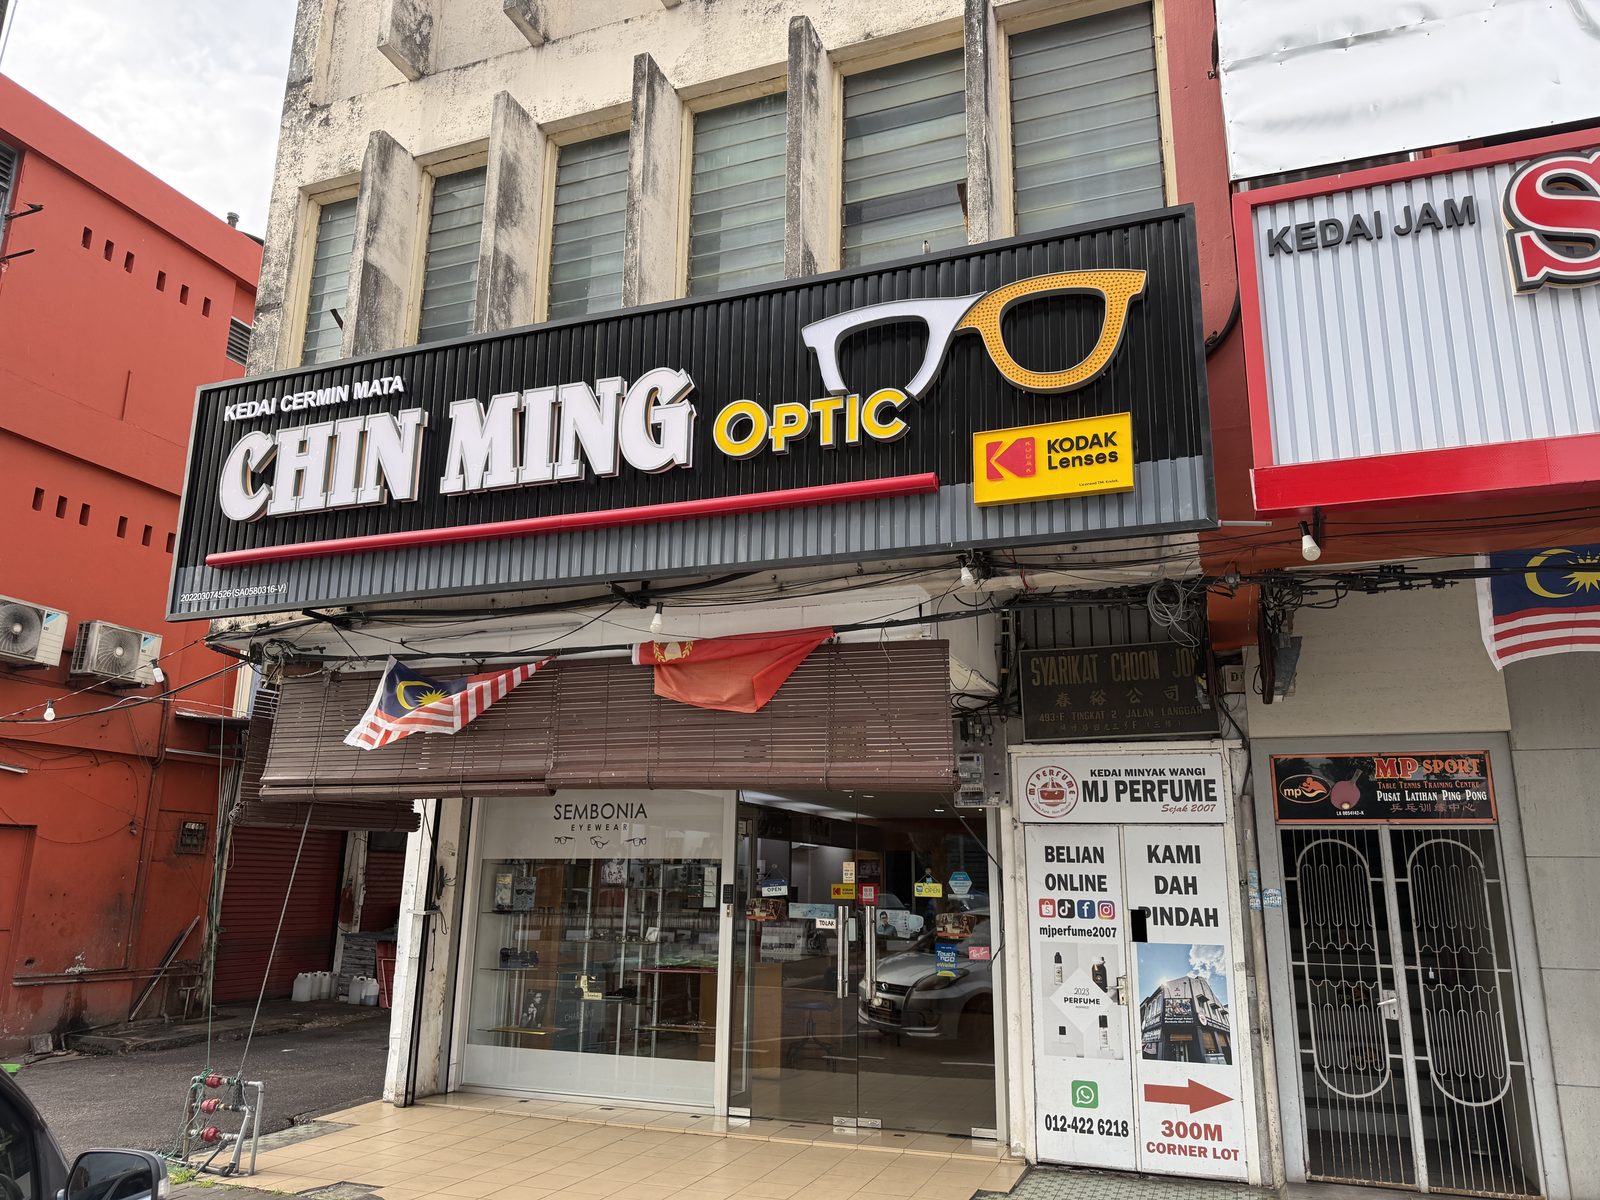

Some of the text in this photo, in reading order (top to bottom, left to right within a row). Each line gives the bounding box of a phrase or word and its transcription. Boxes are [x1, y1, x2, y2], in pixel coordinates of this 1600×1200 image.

[1267, 196, 1475, 256] KEDAI JAM
[224, 376, 404, 421] KEDAI CERMIN MATA
[219, 367, 910, 522] CHIN MING OPTIC
[1047, 431, 1117, 454] KODAK
[1048, 451, 1118, 470] Lenses
[181, 582, 287, 602] 202203074526(SA0580316-V)
[1031, 654, 1098, 686] SYARIKAT
[1111, 650, 1160, 681] CHOON
[1072, 711, 1105, 720] TINGKAT
[1126, 708, 1153, 718] JALAN
[1090, 767, 1206, 777] KEDAI MINYAK WANGI
[1374, 757, 1481, 779] MP SPORT
[1028, 769, 1076, 796] MJ PERFUME
[1082, 779, 1217, 802] MJ PERFUME
[1377, 781, 1396, 789] TABLE
[1424, 780, 1453, 788] TRAINING
[1455, 780, 1479, 788] CENTRE
[1284, 788, 1302, 798] mp
[1376, 789, 1487, 802] PUSAT LATIHAN PING PONG
[553, 803, 648, 820] SEMBONIA
[1161, 804, 1216, 814] Sejak 2007
[570, 823, 629, 831] EYEWEAR
[1044, 845, 1105, 864] BELIAN
[1146, 844, 1201, 864] KAMI
[1044, 873, 1108, 893] ONLINE
[1154, 875, 1198, 895] DAH
[1039, 925, 1117, 939] mjperfume2007
[1063, 996, 1101, 1005] PERFUME
[1073, 987, 1090, 996] 2023
[1045, 1114, 1129, 1138] 012-422 6218
[1161, 1119, 1223, 1142] 300M
[1146, 1141, 1240, 1161] CORNER LOT
